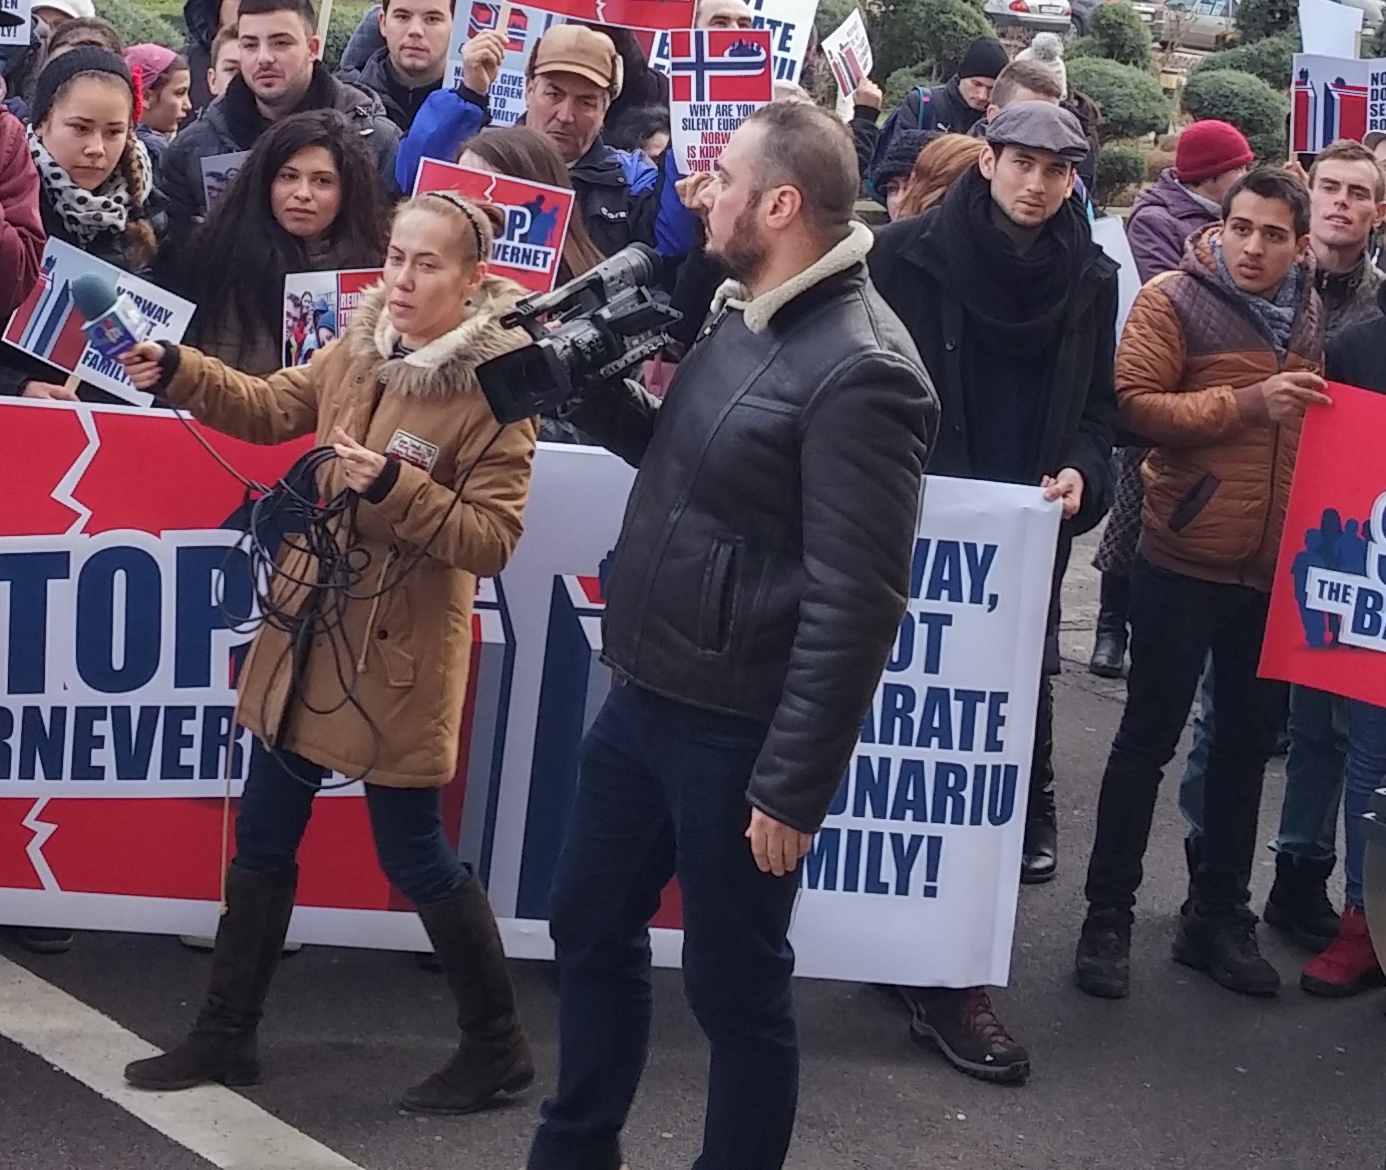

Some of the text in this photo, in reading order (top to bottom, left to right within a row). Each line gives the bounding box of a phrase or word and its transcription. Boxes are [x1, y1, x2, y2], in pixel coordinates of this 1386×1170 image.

[500, 73, 524, 87] GIVE
[493, 97, 507, 108] TO
[689, 104, 712, 117] WHY
[715, 104, 733, 117] ARE
[682, 118, 746, 131] SILENT EURO
[701, 132, 731, 145] NORW
[687, 145, 696, 158] IS
[686, 159, 711, 172] YOUR
[1317, 578, 1354, 605] THE
[803, 828, 943, 898] MILY!
